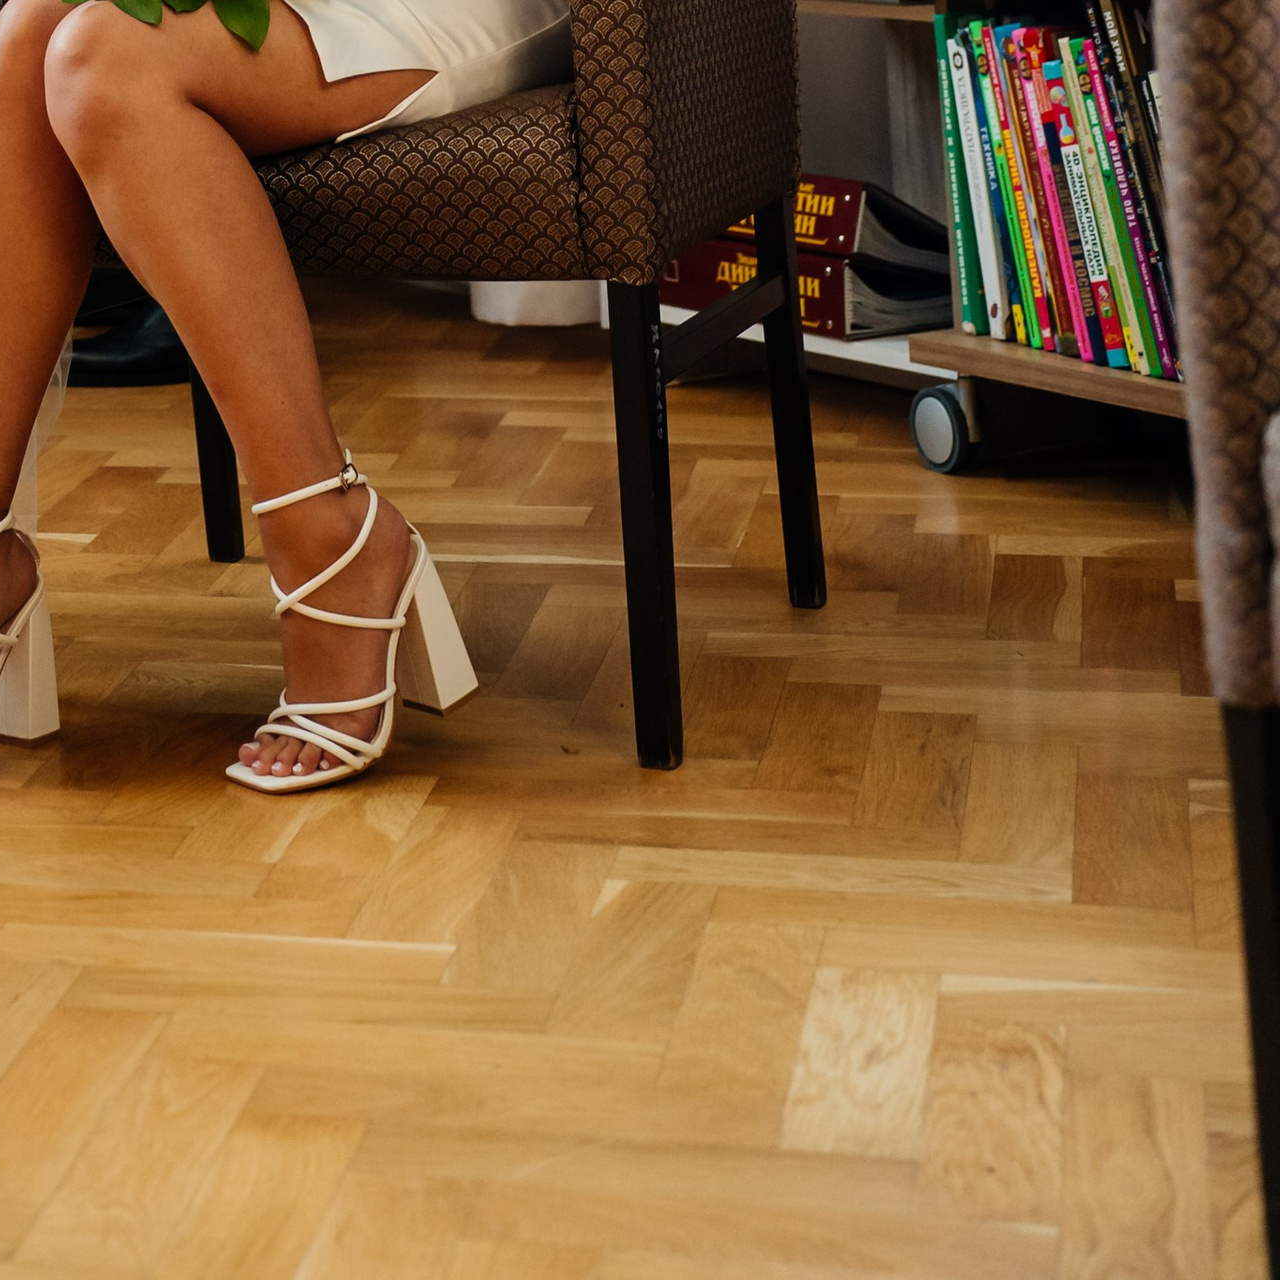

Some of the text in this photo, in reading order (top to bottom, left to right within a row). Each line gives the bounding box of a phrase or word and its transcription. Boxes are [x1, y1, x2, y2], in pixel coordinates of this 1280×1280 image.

[1103, 10, 1125, 73] МОЙ ХРАМ
[1079, 72, 1094, 96] 4D
[981, 126, 998, 192] ТЕХНИКА
[1002, 129, 1022, 186] ЗНАНИЙ
[1110, 140, 1137, 228] ТЕЛО ЧЕЛОВЕКА
[1015, 189, 1043, 298] КАЛЕЙДОСКОП
[1064, 151, 1090, 245] ЗАНИМАТЕЛЬНЫХ
[1086, 248, 1097, 277] НАУК
[1075, 171, 1104, 277] ЭНЦИКЛОПЕДИЯ
[1075, 259, 1096, 318] КОСМОС
